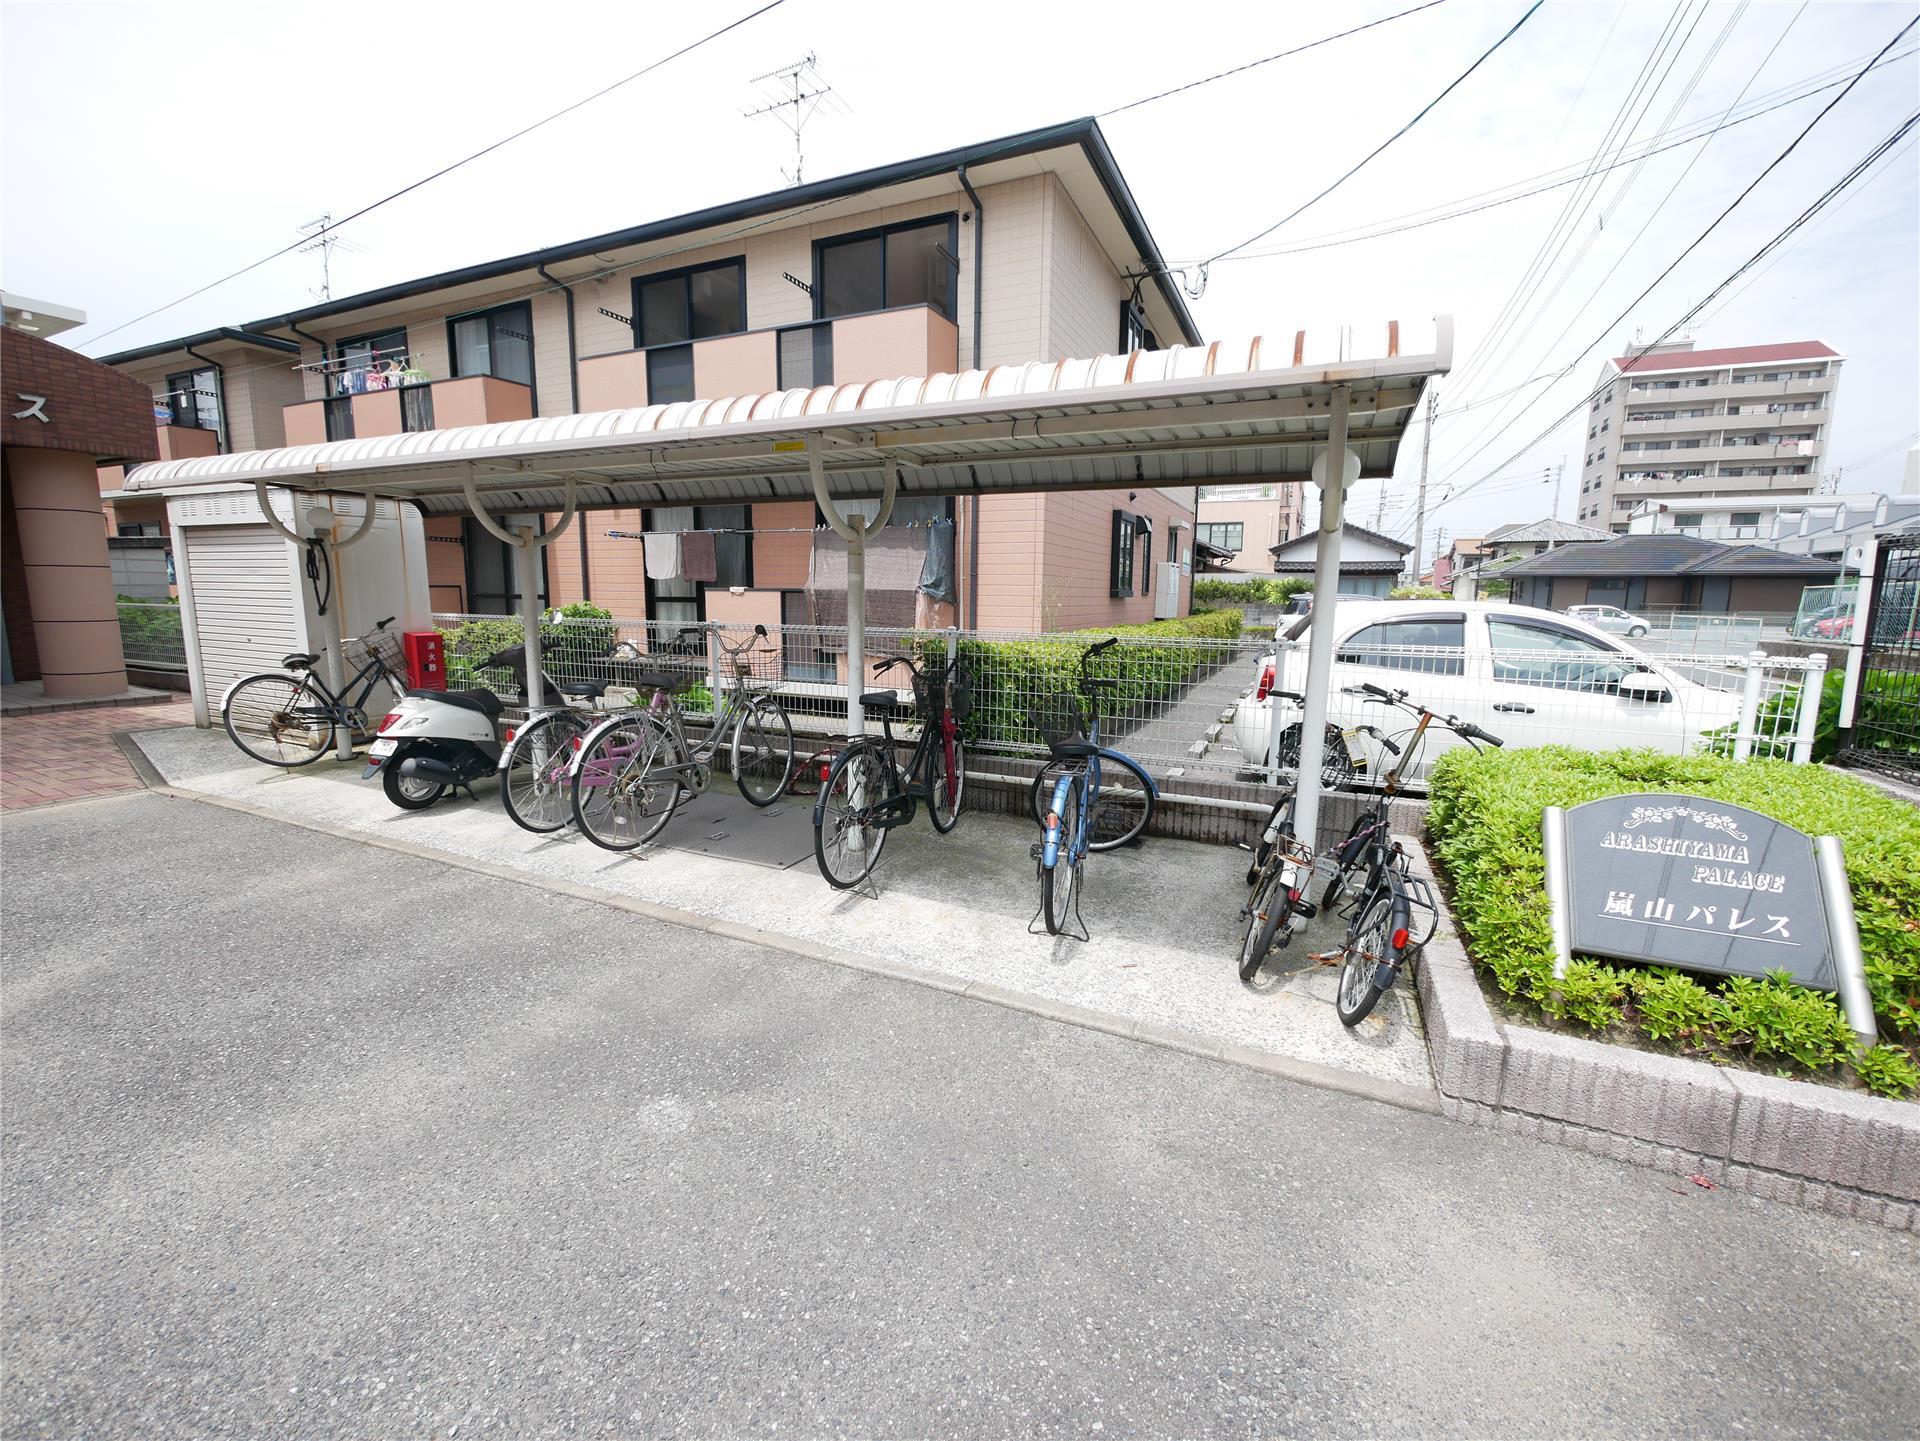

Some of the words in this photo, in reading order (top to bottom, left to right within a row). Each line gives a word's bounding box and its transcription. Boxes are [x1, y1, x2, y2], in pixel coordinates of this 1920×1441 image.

[11, 393, 50, 424] ス
[1600, 831, 1750, 864] ARASHIYAMA
[1691, 865, 1786, 893] PALACE
[1603, 890, 1791, 938] 嵐山パレス
